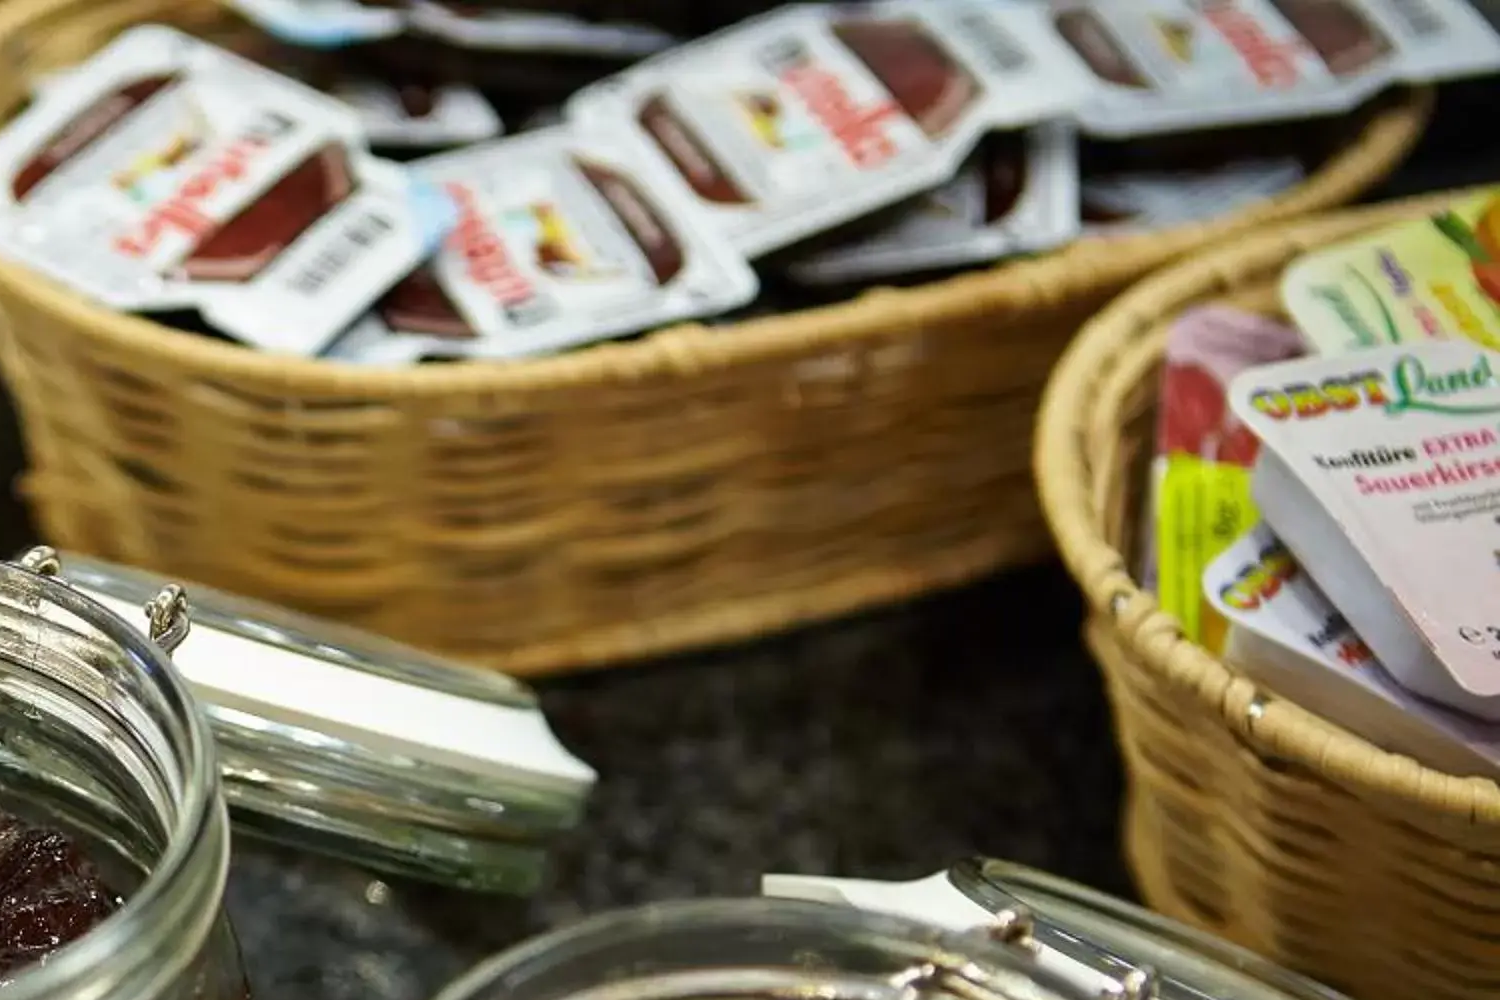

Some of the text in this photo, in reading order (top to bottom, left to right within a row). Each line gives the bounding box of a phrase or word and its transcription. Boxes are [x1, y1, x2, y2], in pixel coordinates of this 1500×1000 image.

[1250, 368, 1388, 420] OBST
[1312, 427, 1497, 470] Konfitüre EXTRA
